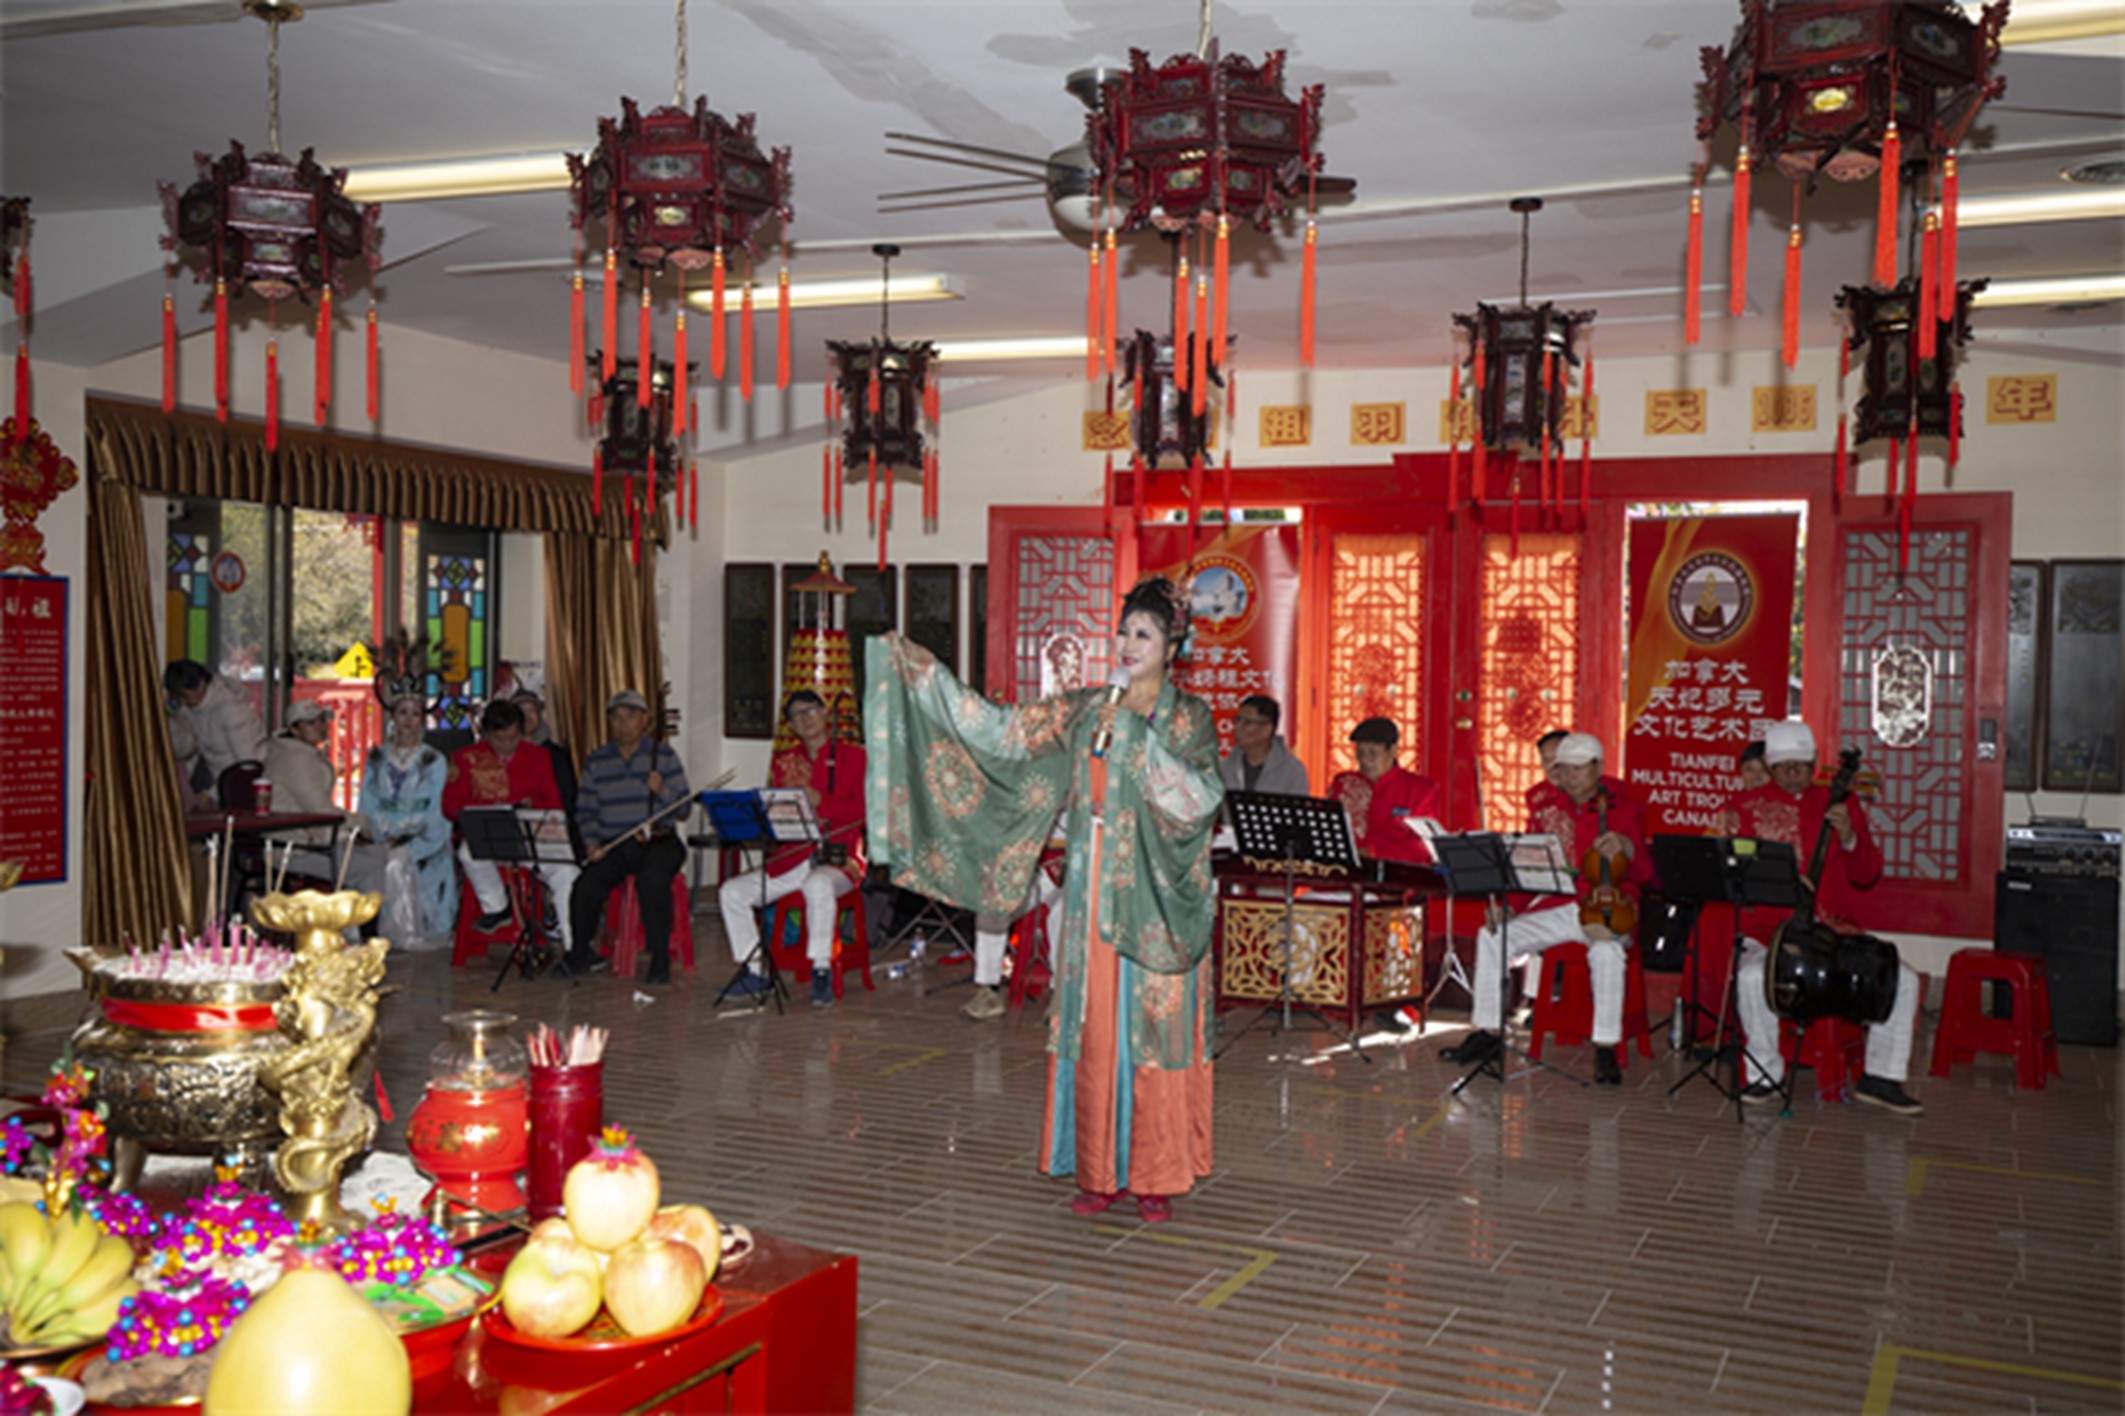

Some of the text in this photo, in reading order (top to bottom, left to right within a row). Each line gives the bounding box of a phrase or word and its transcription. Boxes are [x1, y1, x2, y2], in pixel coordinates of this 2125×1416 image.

[1664, 658, 1750, 685] 加拿大
[1669, 752, 1735, 771] TIANFEI
[1648, 788, 1725, 809] ART TRO
[1662, 808, 1716, 828] CANA
